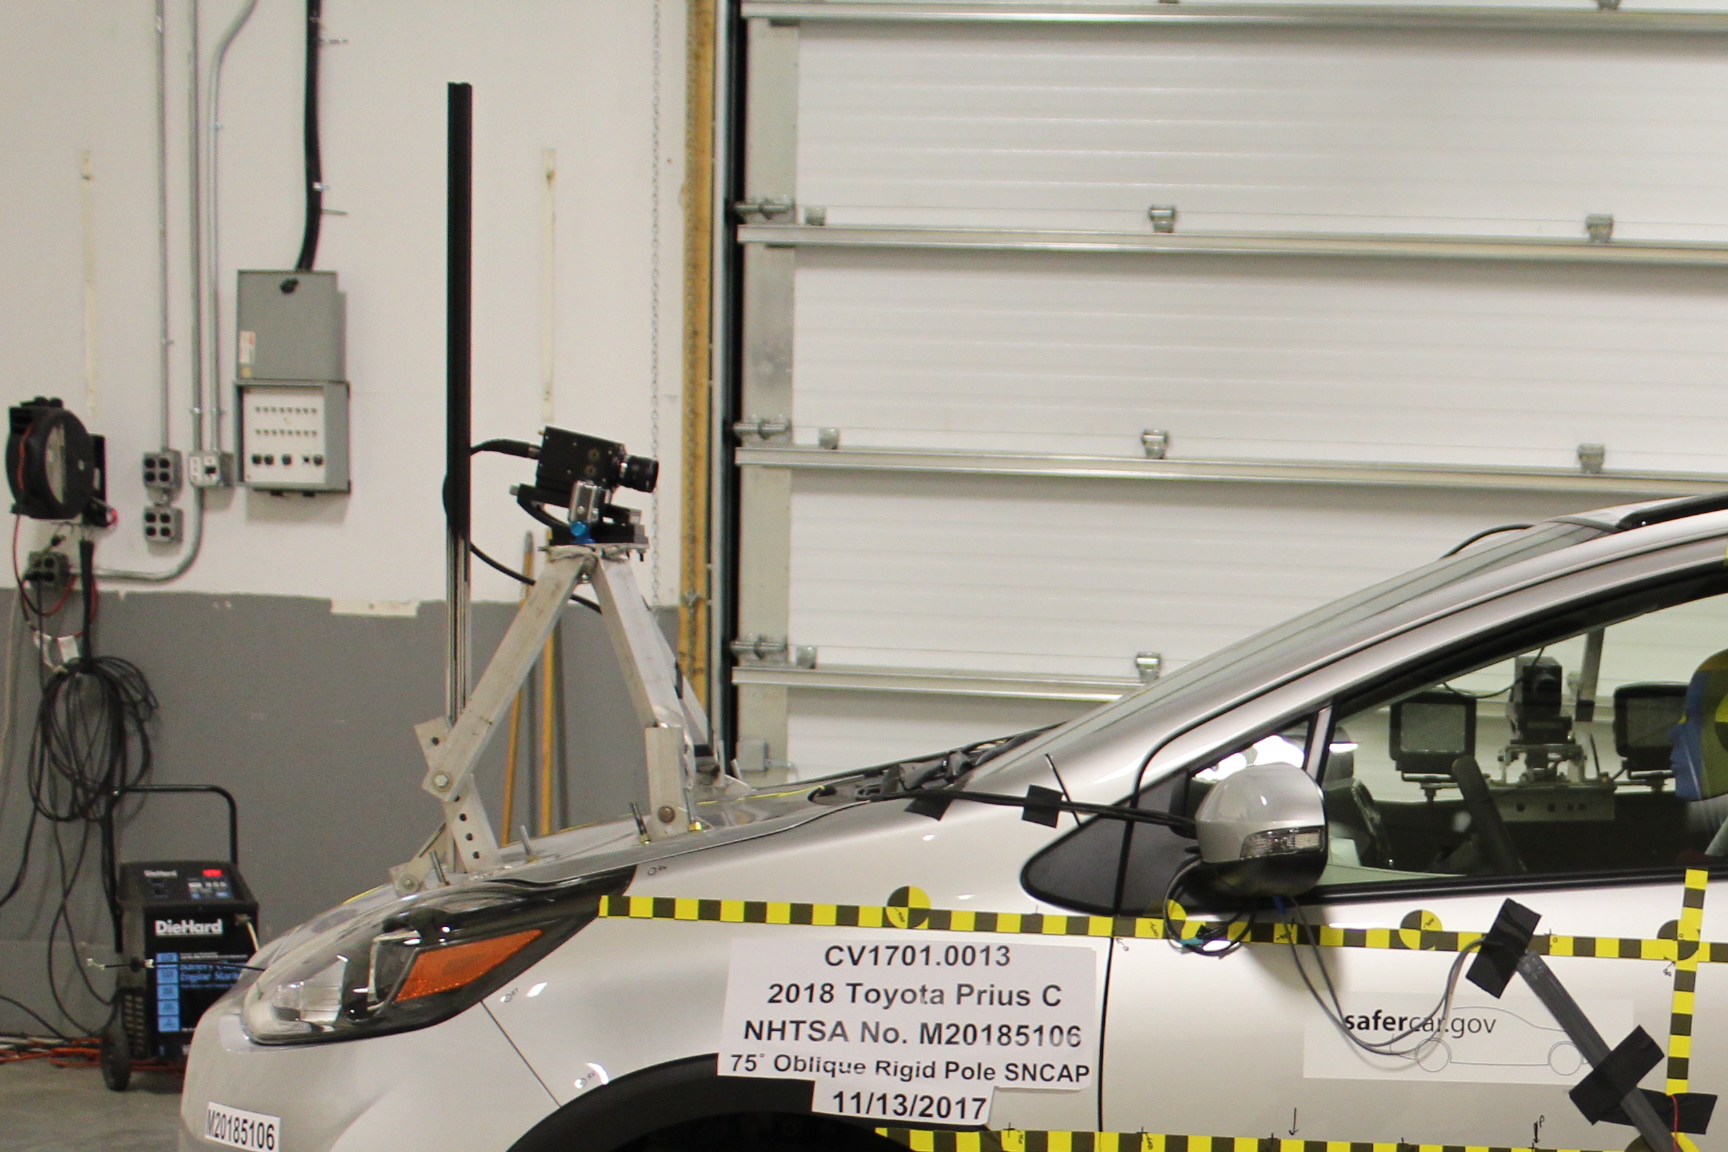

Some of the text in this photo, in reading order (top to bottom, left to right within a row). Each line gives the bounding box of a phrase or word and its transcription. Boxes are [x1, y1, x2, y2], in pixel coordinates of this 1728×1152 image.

[155, 918, 223, 936] DieHard
[824, 945, 1011, 967] CV1701.0013
[767, 983, 1063, 1010] 2018 Toyota Prius C
[743, 1020, 1082, 1048] NHTSA No. M20185106
[1344, 1009, 1497, 1039] safercar.gov
[773, 1054, 867, 1078] Oblique
[875, 1060, 936, 1083] Rigid
[944, 1061, 996, 1081] Pole
[1004, 1063, 1090, 1084] SNCAP
[833, 1091, 988, 1120] 11/13/2017
[207, 1108, 276, 1151] M20185106
